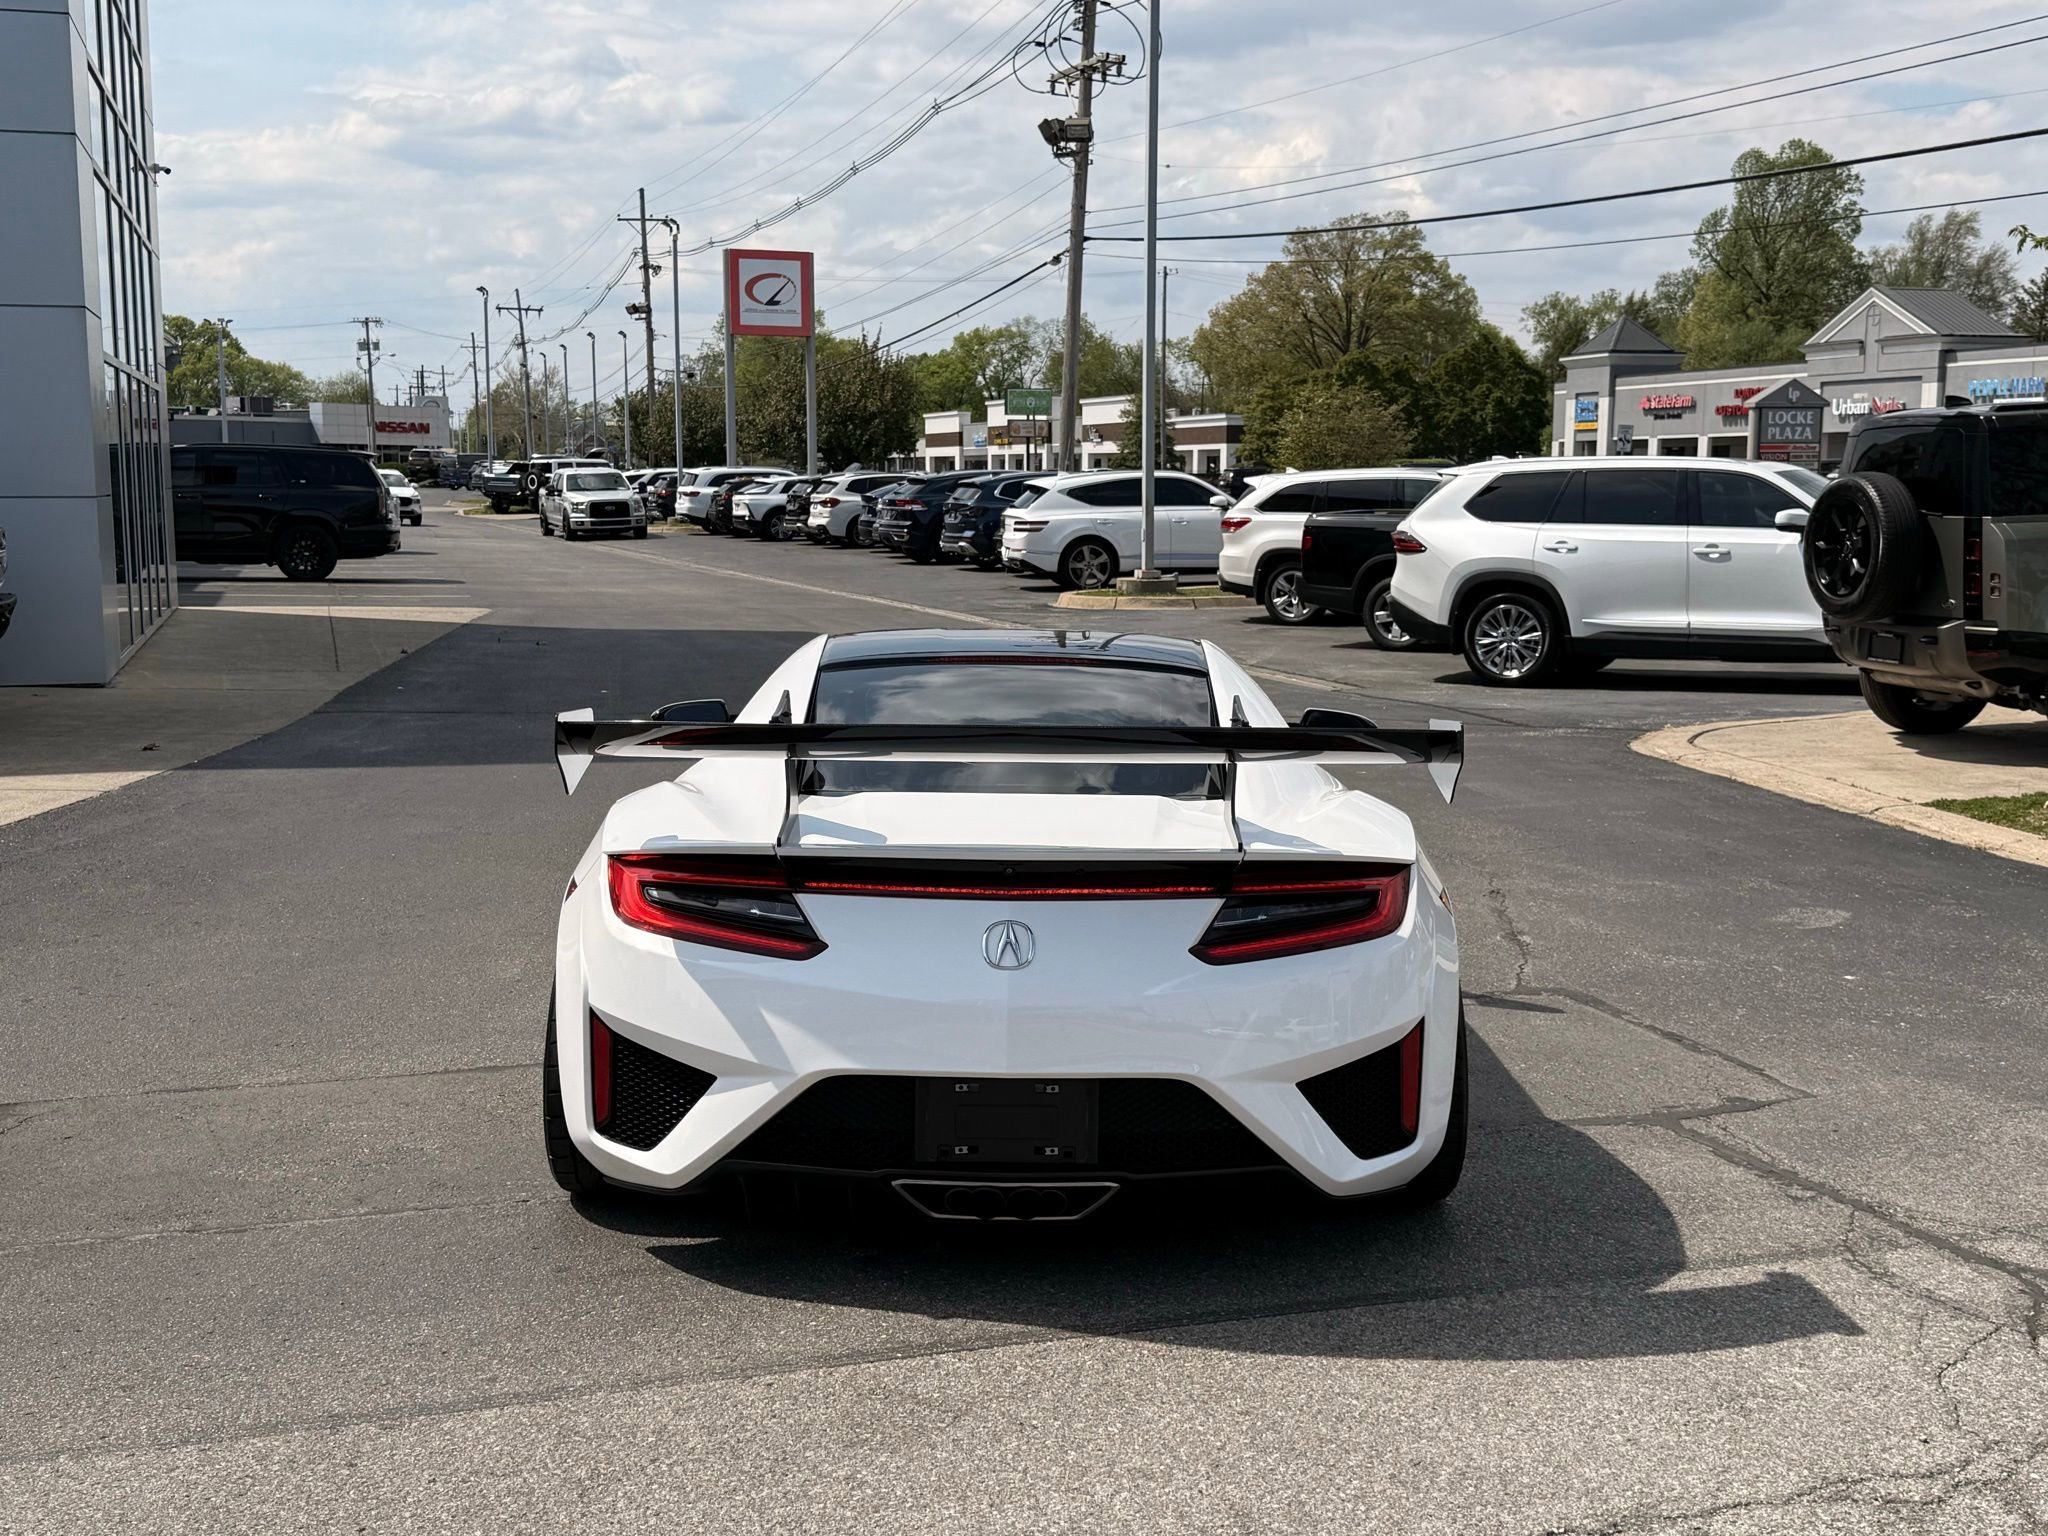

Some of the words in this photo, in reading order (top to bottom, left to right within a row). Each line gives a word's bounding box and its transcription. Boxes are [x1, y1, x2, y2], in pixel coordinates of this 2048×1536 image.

[1832, 398, 1869, 416] Urban
[1871, 396, 1905, 414] Nails
[1768, 411, 1814, 424] LOCKE
[375, 421, 430, 434] NISSAN
[1768, 426, 1812, 440] PLAZA
